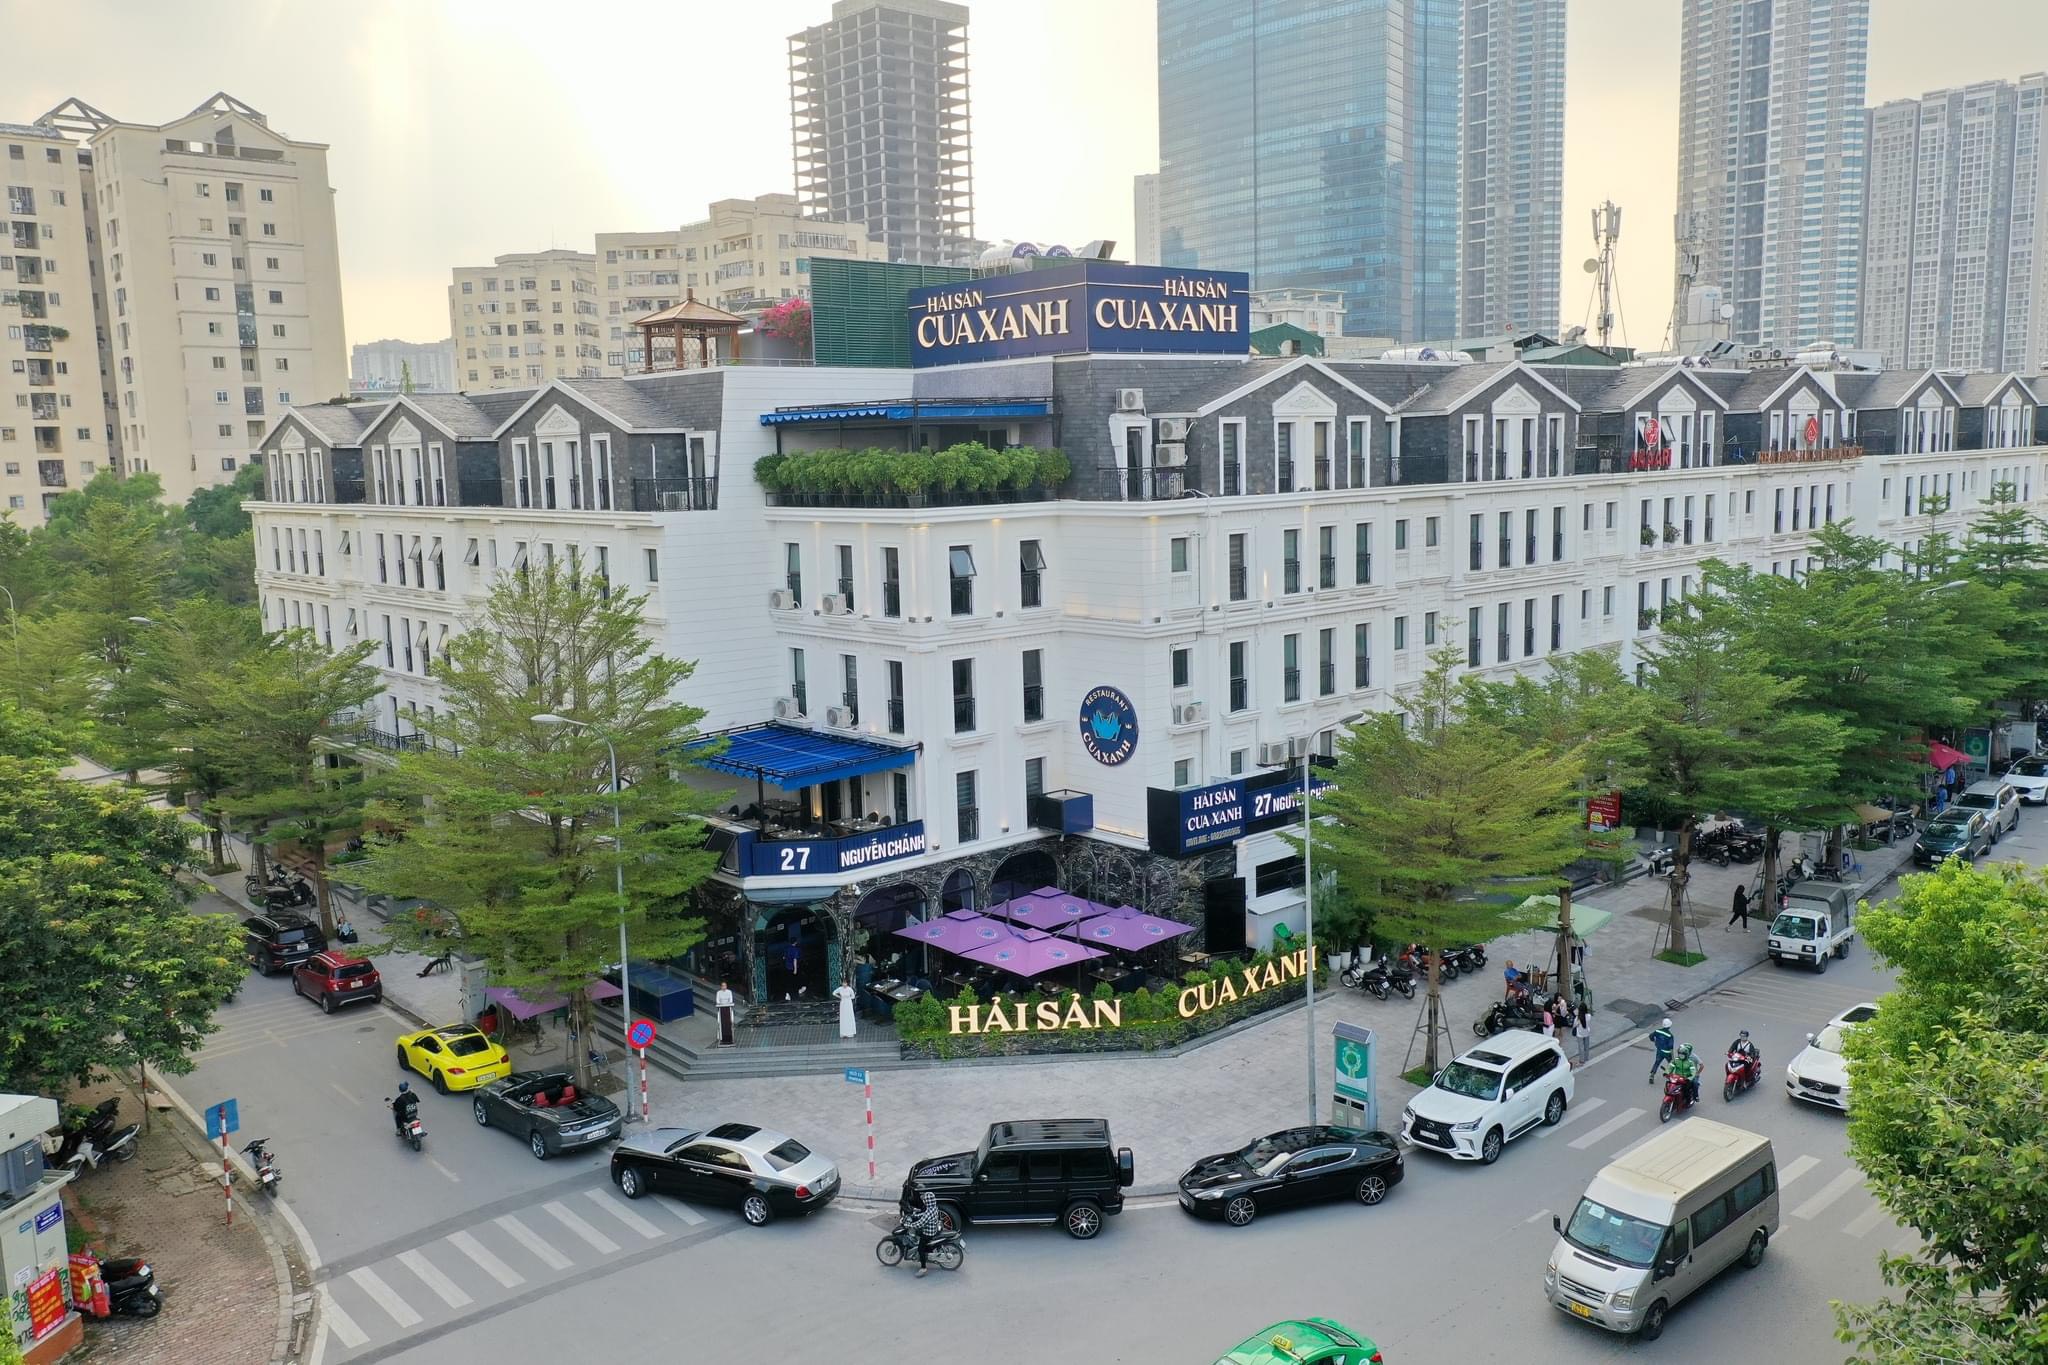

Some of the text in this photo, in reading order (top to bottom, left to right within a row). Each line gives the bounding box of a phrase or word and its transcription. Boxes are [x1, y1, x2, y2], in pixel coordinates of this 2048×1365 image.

[927, 288, 983, 313] HẢI SẢN
[1164, 275, 1227, 299] HẢI SẢN
[917, 299, 1070, 348] CUA XANH
[1095, 298, 1238, 332] CUA XANH
[1085, 689, 1129, 712] RESTAURANT
[1187, 806, 1242, 831] CUA XANH
[1255, 793, 1272, 817] 27
[781, 833, 925, 871] 27 NGUYỄN CHÁNH
[1178, 945, 1317, 1018] CUA XANH
[948, 992, 1122, 1034] HẢI SẢN
